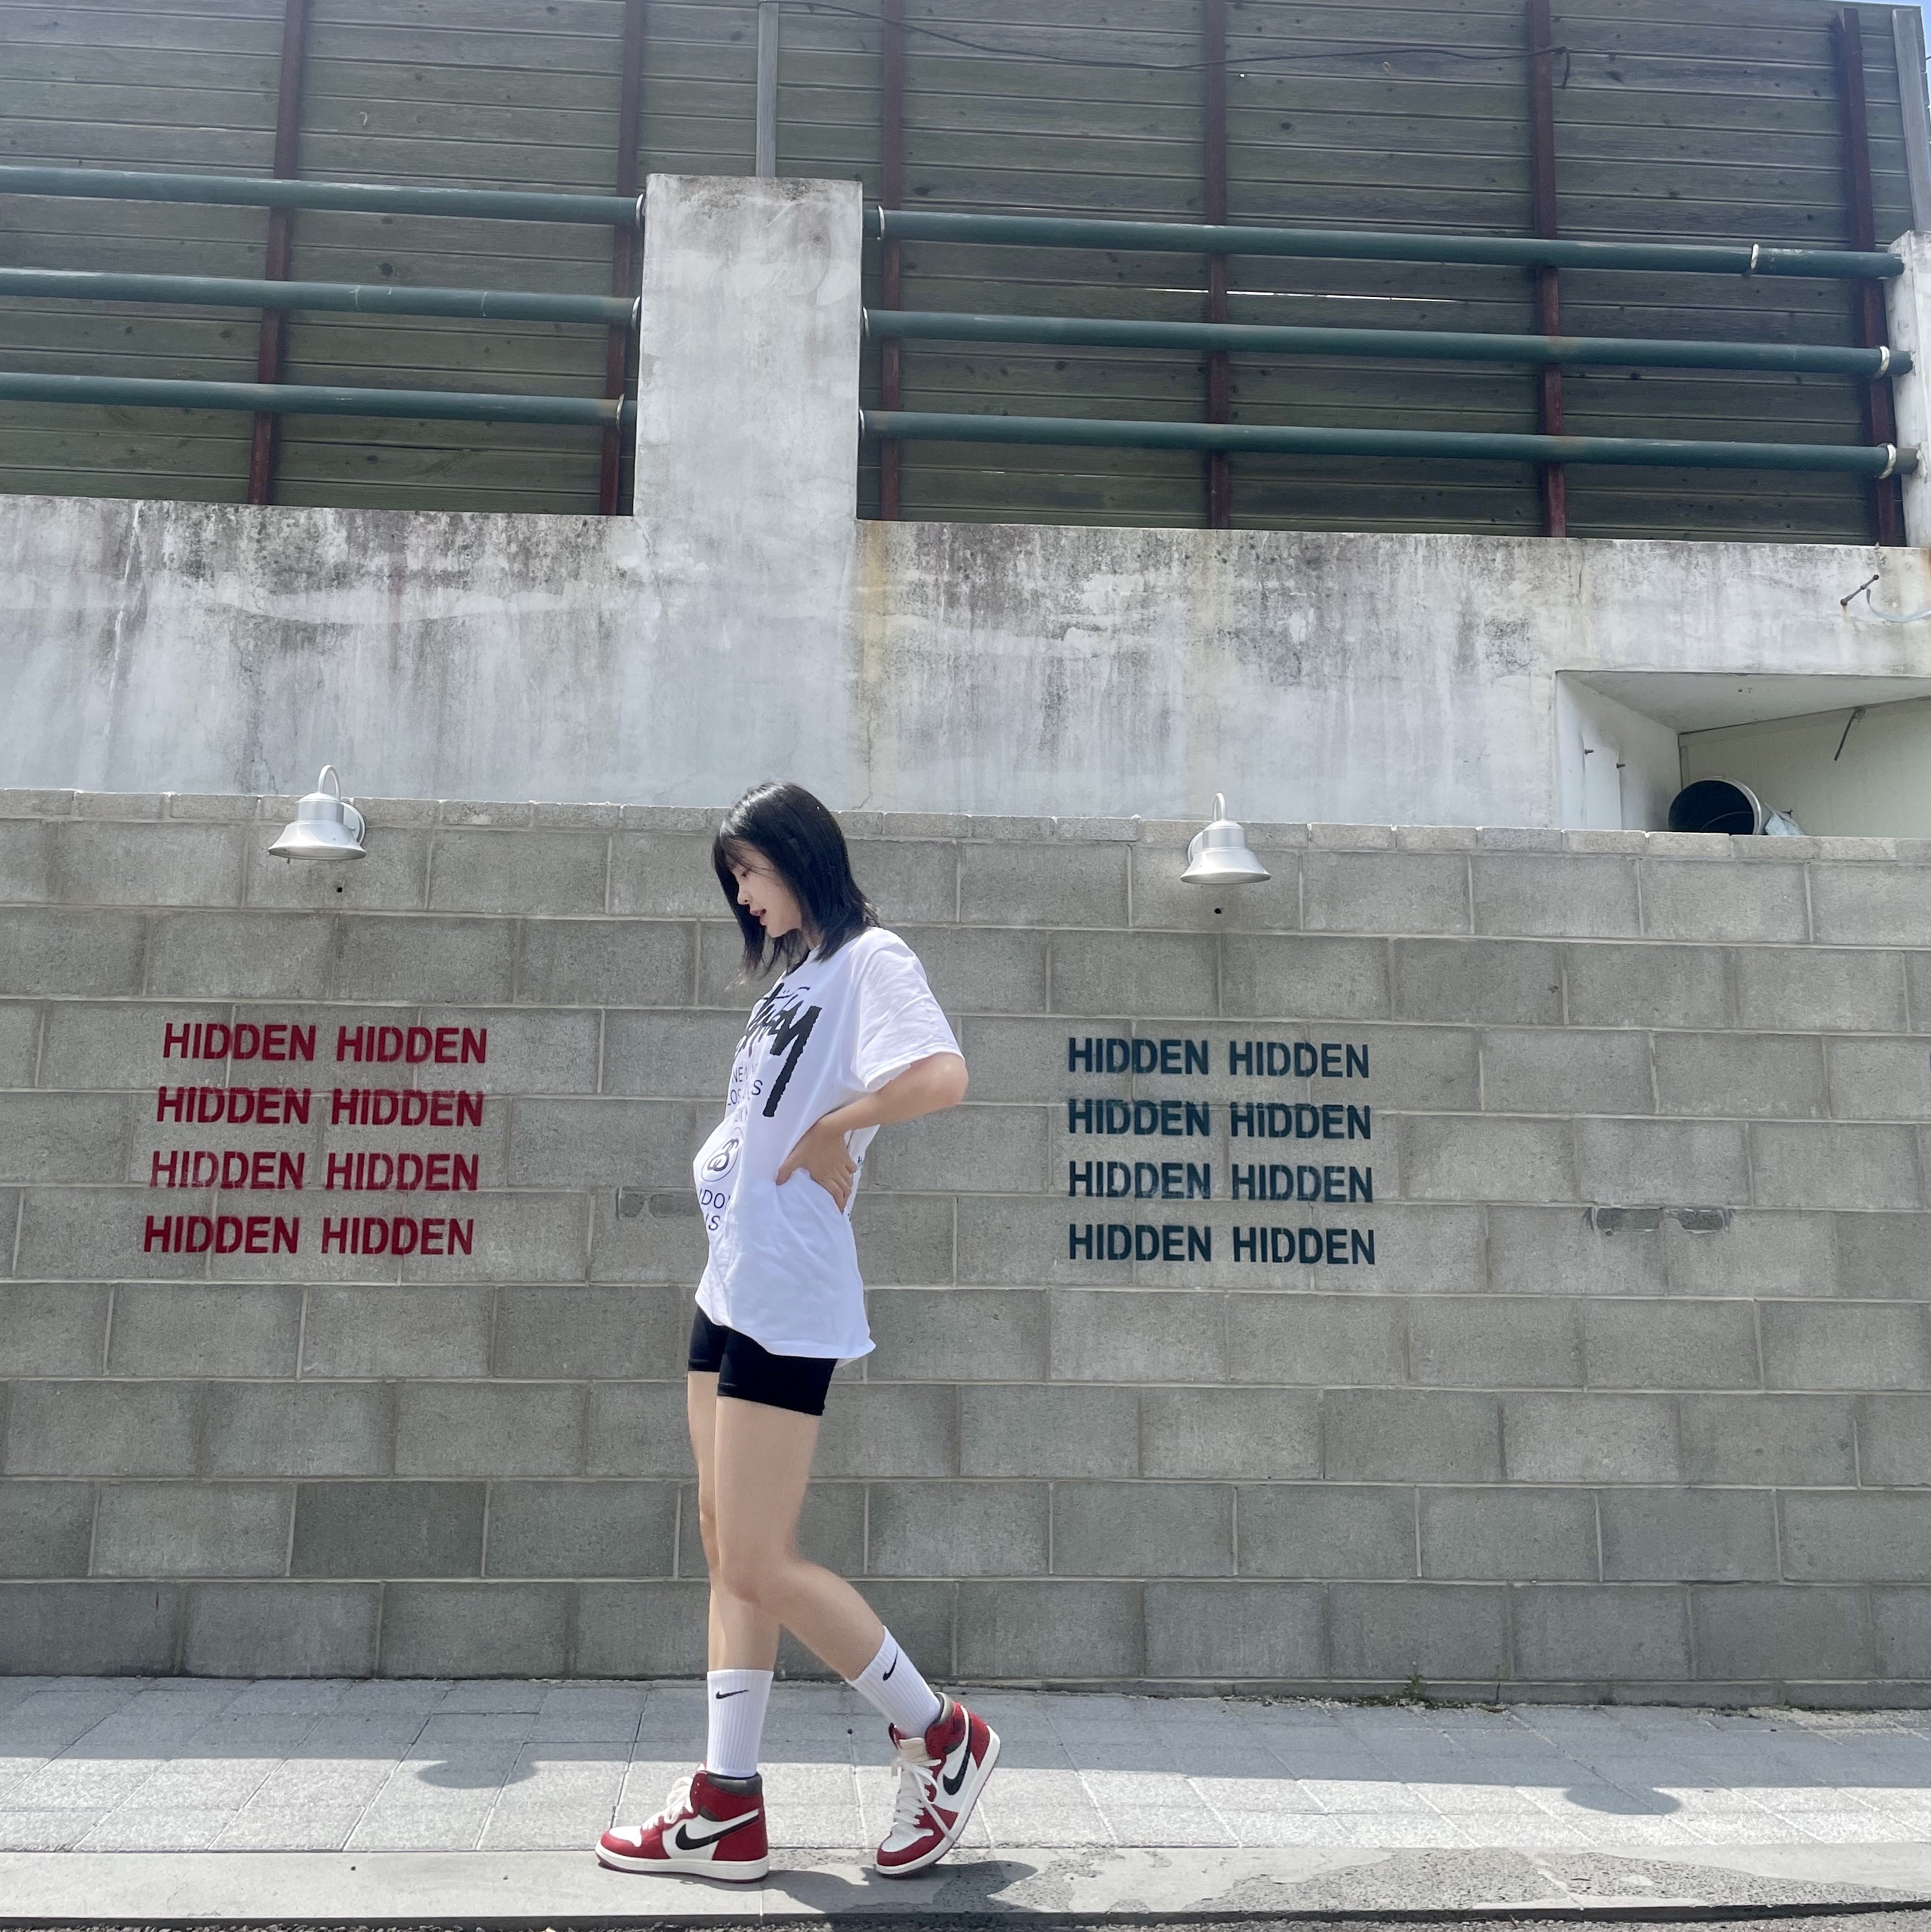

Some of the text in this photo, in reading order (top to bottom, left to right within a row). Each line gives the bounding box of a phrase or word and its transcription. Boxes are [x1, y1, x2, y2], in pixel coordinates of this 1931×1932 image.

[163, 1023, 487, 1063] HIDDEN HIDDEN
[1067, 1037, 1370, 1078] HIDDEN HIDDEN
[156, 1086, 484, 1127] HIDDEN HIDDEN
[1067, 1098, 1371, 1139] HIDDEN HIDDEN
[151, 1151, 478, 1191] HIDDEN HIDDEN
[1067, 1160, 1374, 1203] HIDDEN HIDDEN
[144, 1215, 473, 1256] HIDDEN HIDDEN
[1068, 1223, 1376, 1265] HIDDEN HIDDEN
